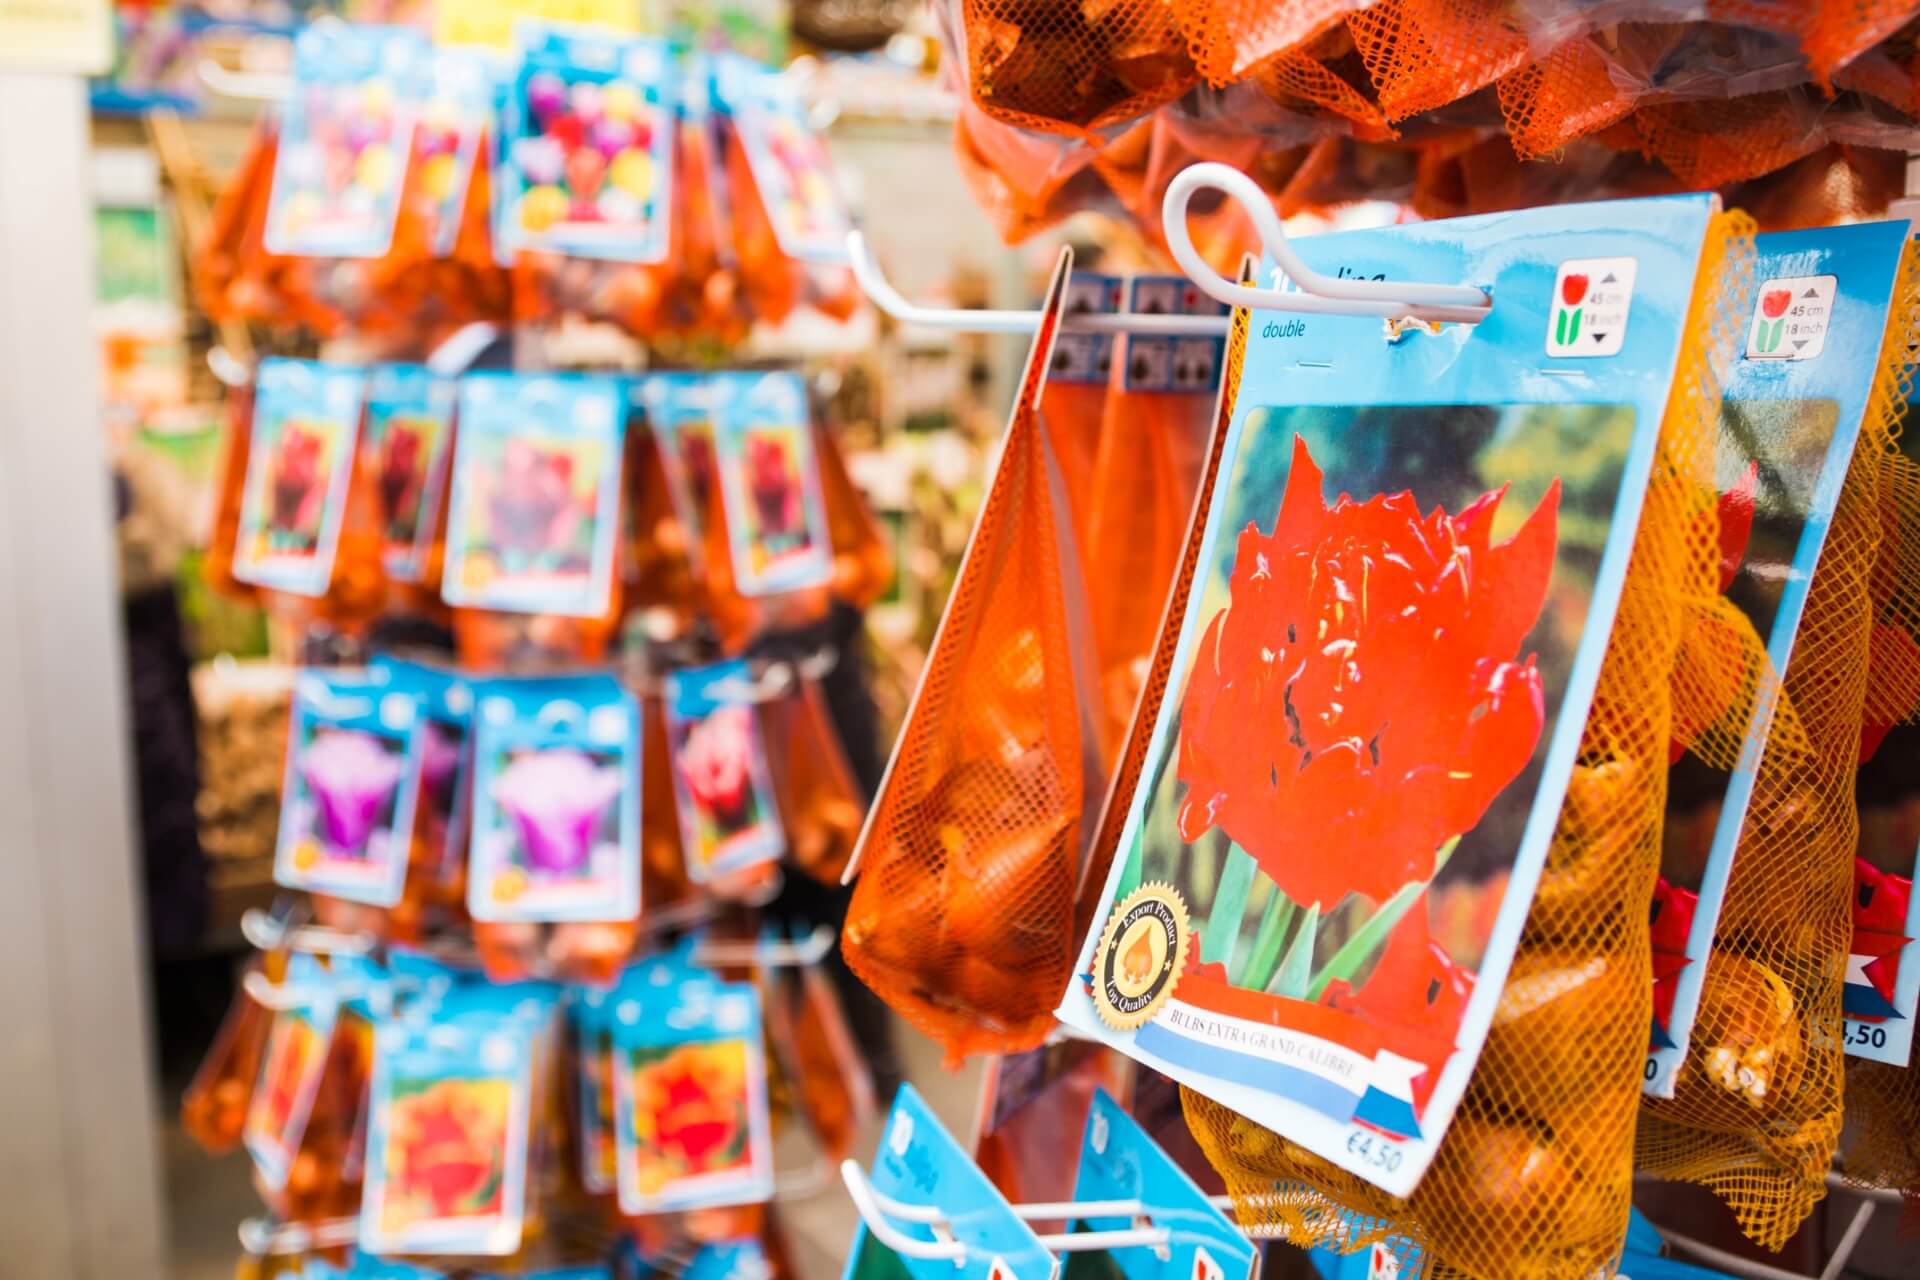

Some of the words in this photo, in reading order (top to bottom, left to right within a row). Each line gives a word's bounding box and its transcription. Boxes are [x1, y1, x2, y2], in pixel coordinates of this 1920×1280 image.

[1262, 319, 1306, 338] double
[1785, 324, 1798, 335] 18
[1800, 321, 1823, 335] inch
[1790, 306, 1805, 317] 45
[1807, 306, 1824, 317] cm
[1122, 901, 1155, 929] Export
[1154, 901, 1177, 947] Product
[1105, 975, 1119, 1001] Top
[1118, 990, 1153, 1013] Quality
[1170, 1009, 1206, 1032] BULBS
[1207, 1021, 1247, 1043] EXTRA
[1249, 1032, 1294, 1054] GRAND
[1297, 1045, 1355, 1077] CALIBRE
[1346, 1131, 1403, 1173] €4,50
